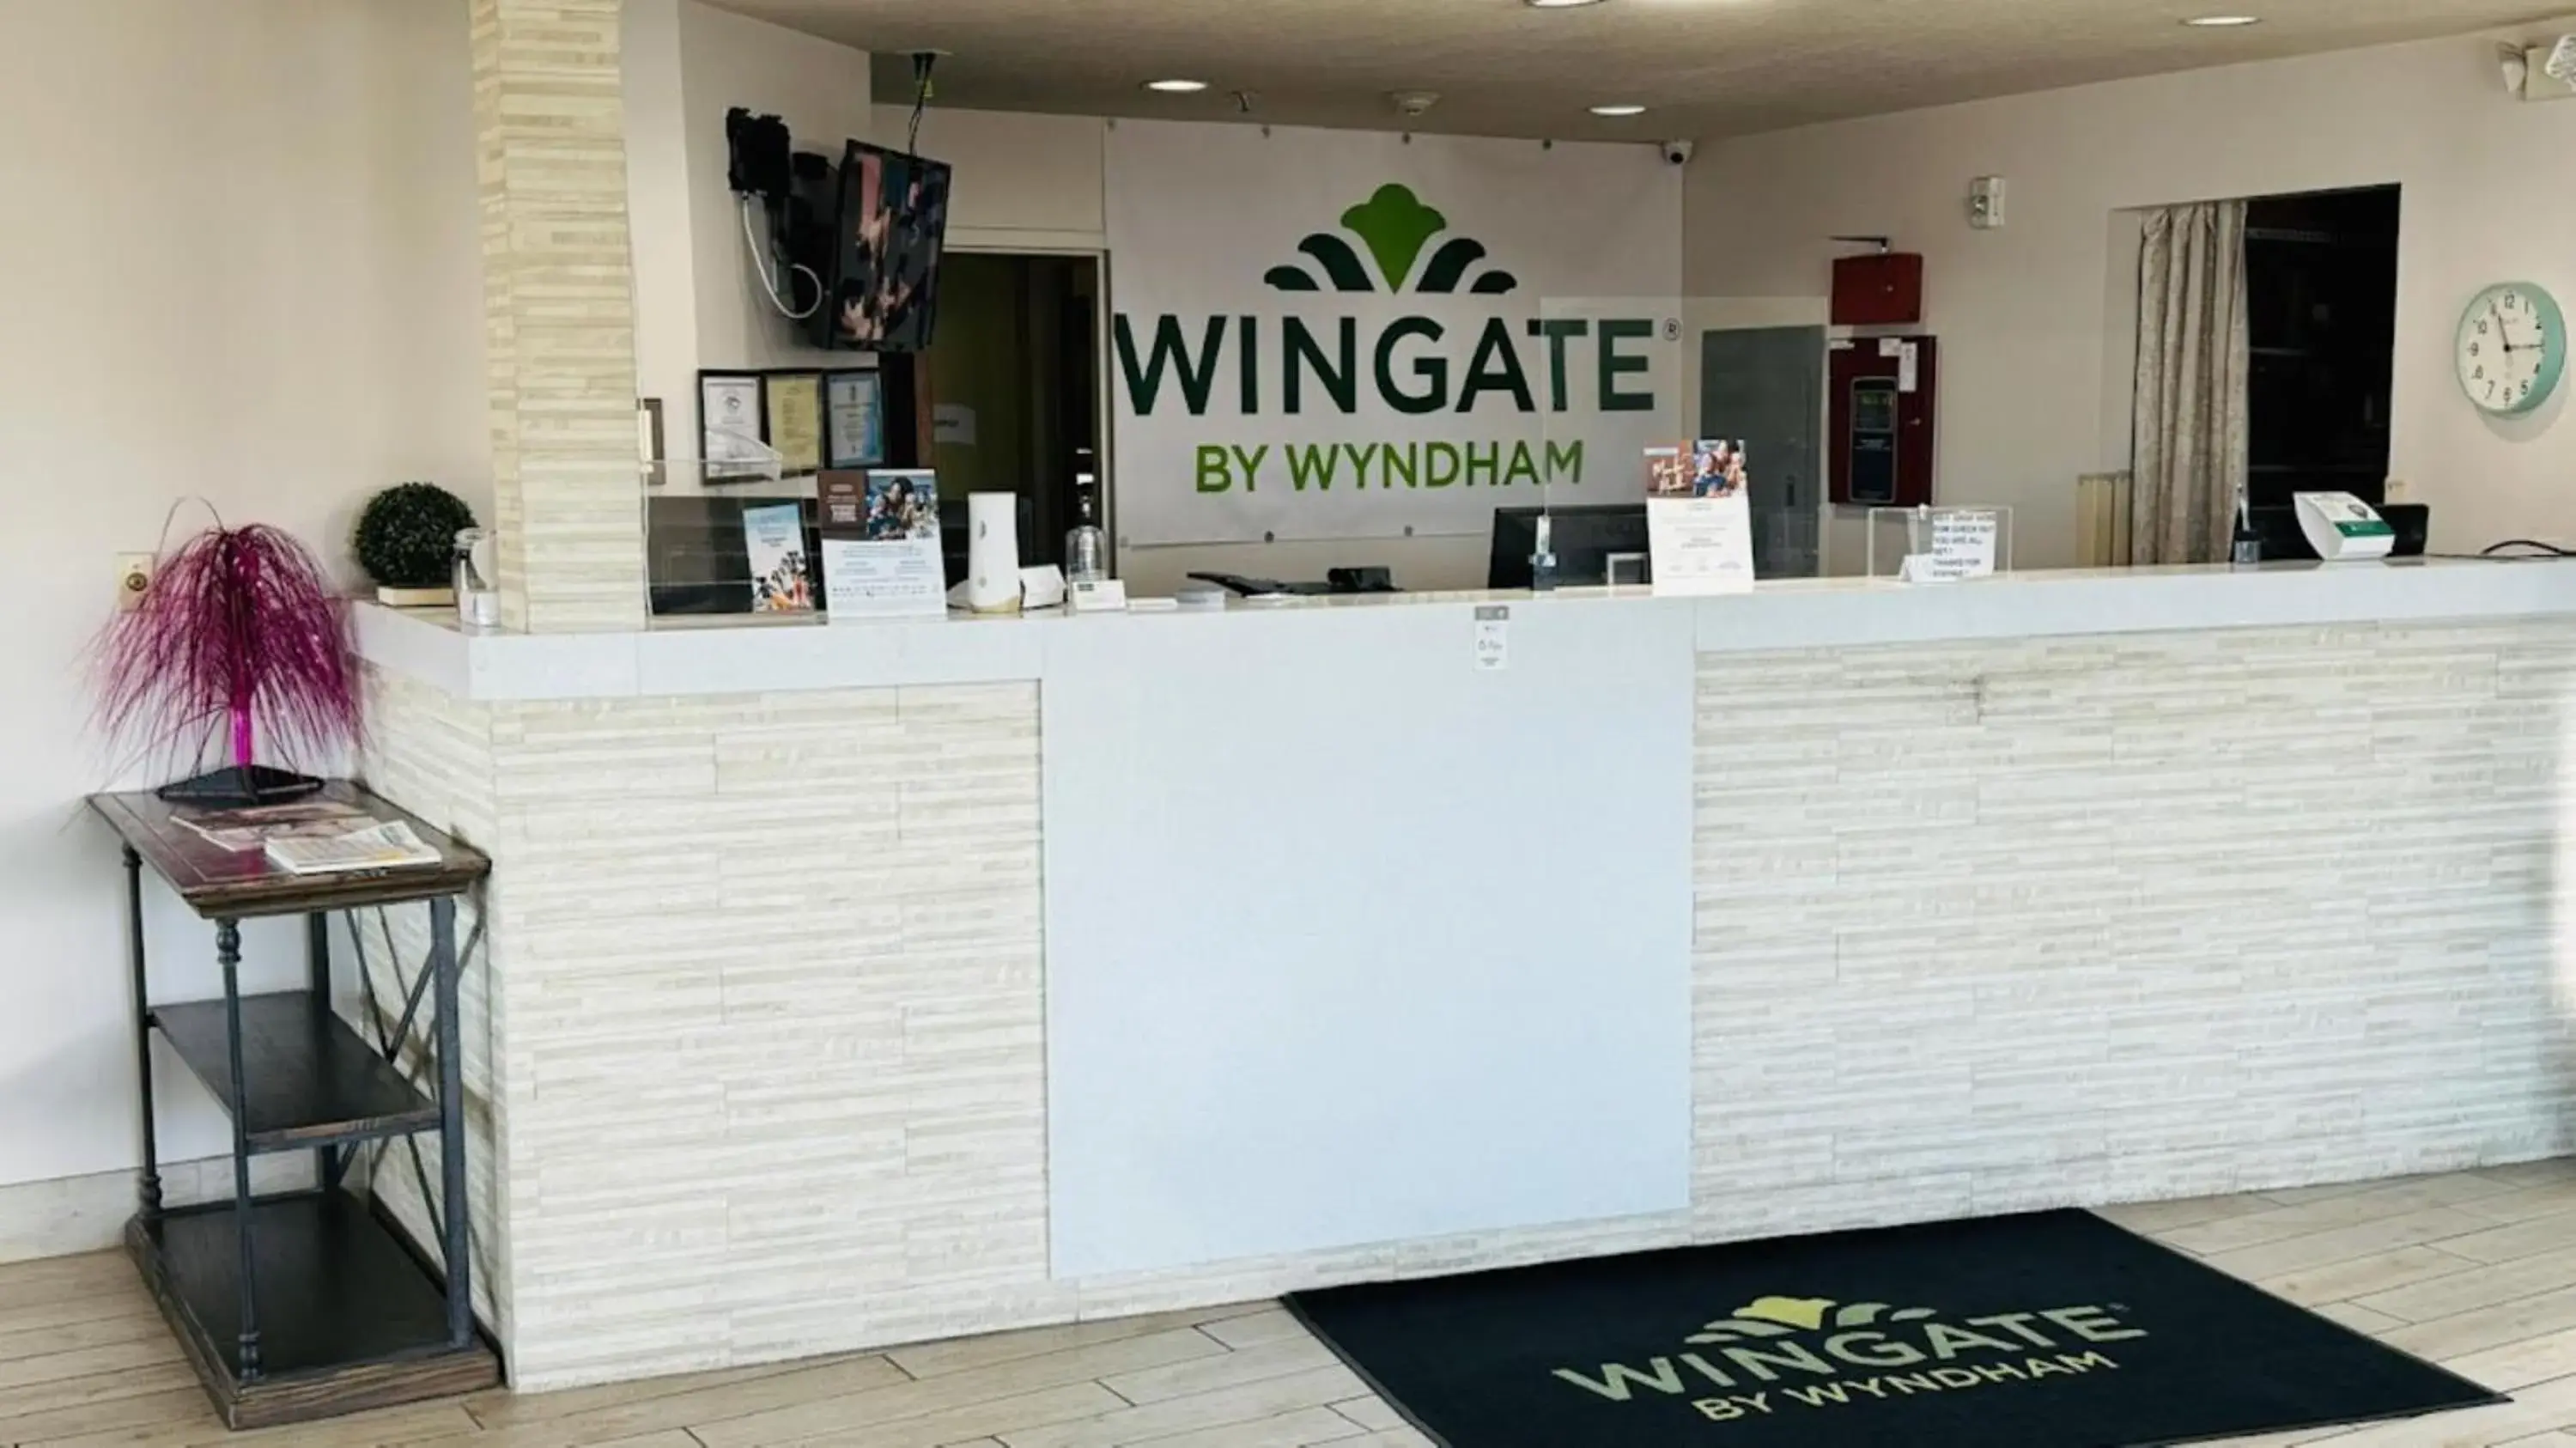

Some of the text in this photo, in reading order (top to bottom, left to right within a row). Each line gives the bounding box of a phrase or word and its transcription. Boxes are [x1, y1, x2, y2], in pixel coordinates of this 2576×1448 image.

[1196, 440, 1583, 493] BY WYNDHAM
[1691, 1349, 2120, 1422] BY WYNDHAM
